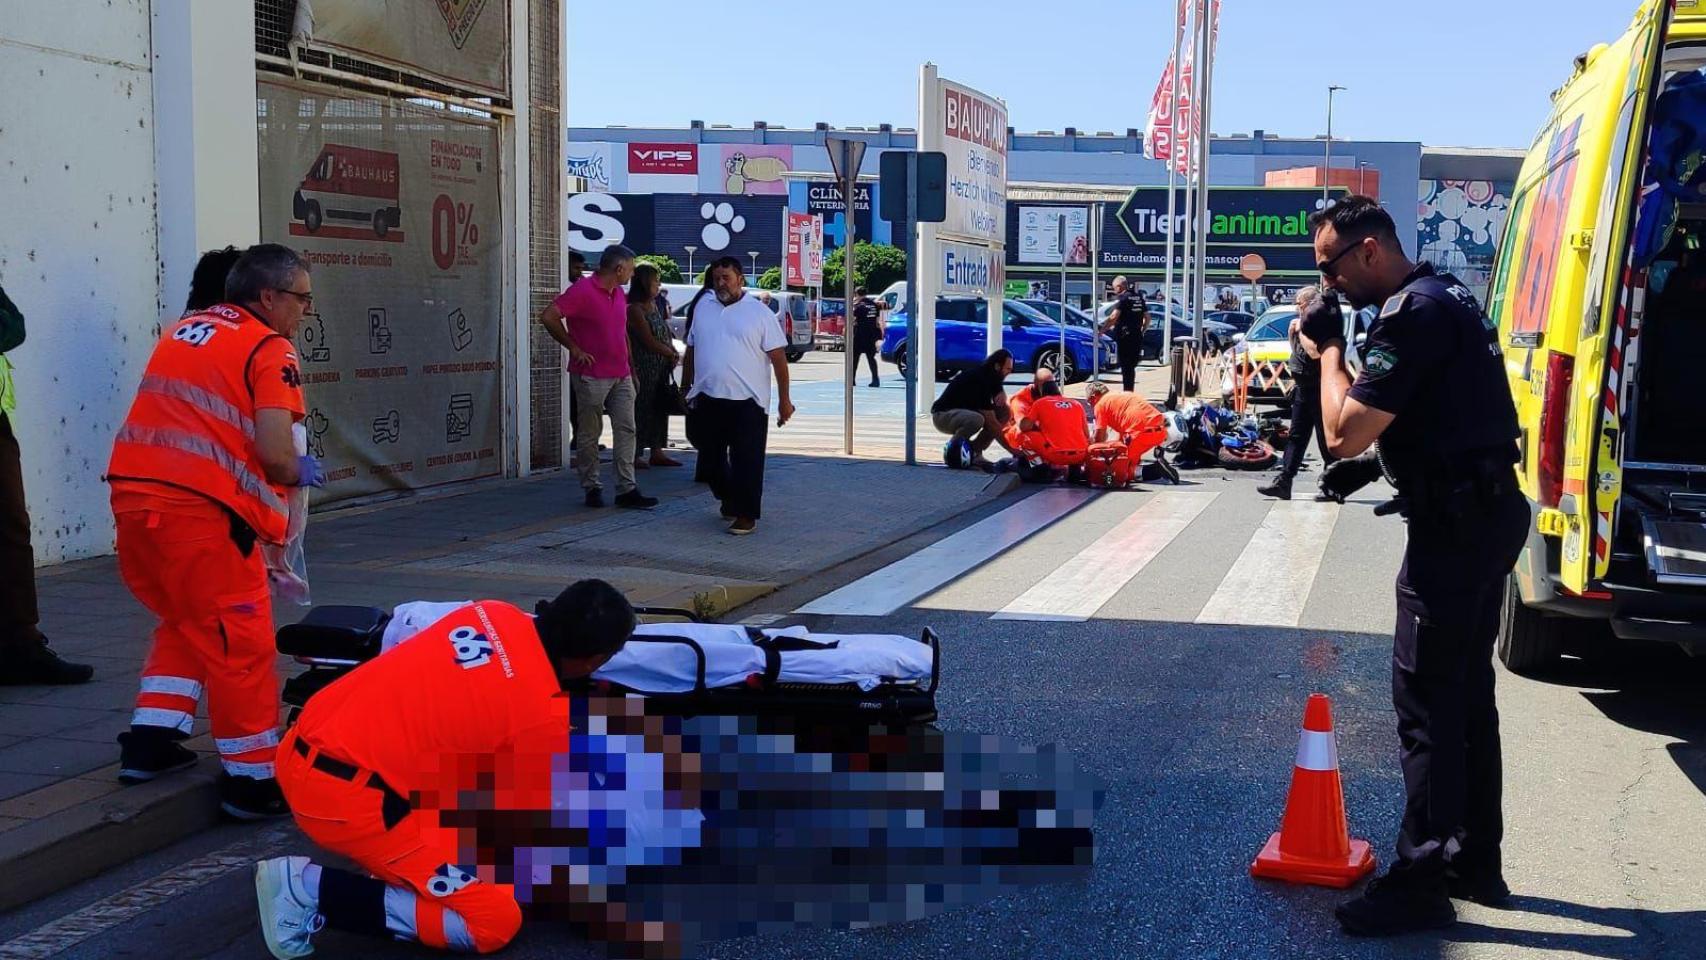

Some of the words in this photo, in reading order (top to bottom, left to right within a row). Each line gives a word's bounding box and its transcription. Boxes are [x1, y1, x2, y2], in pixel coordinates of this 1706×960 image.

[947, 96, 1006, 149] BAUHAU
[633, 150, 693, 161] VIPS
[348, 164, 395, 183] BAUHAUS
[809, 184, 870, 200] CLÍNCA
[809, 201, 870, 210] VETERINRIA
[303, 249, 350, 267] Transporte
[1103, 252, 1169, 264] Entendemo
[946, 252, 988, 287] Entrada
[449, 625, 493, 670] 061
